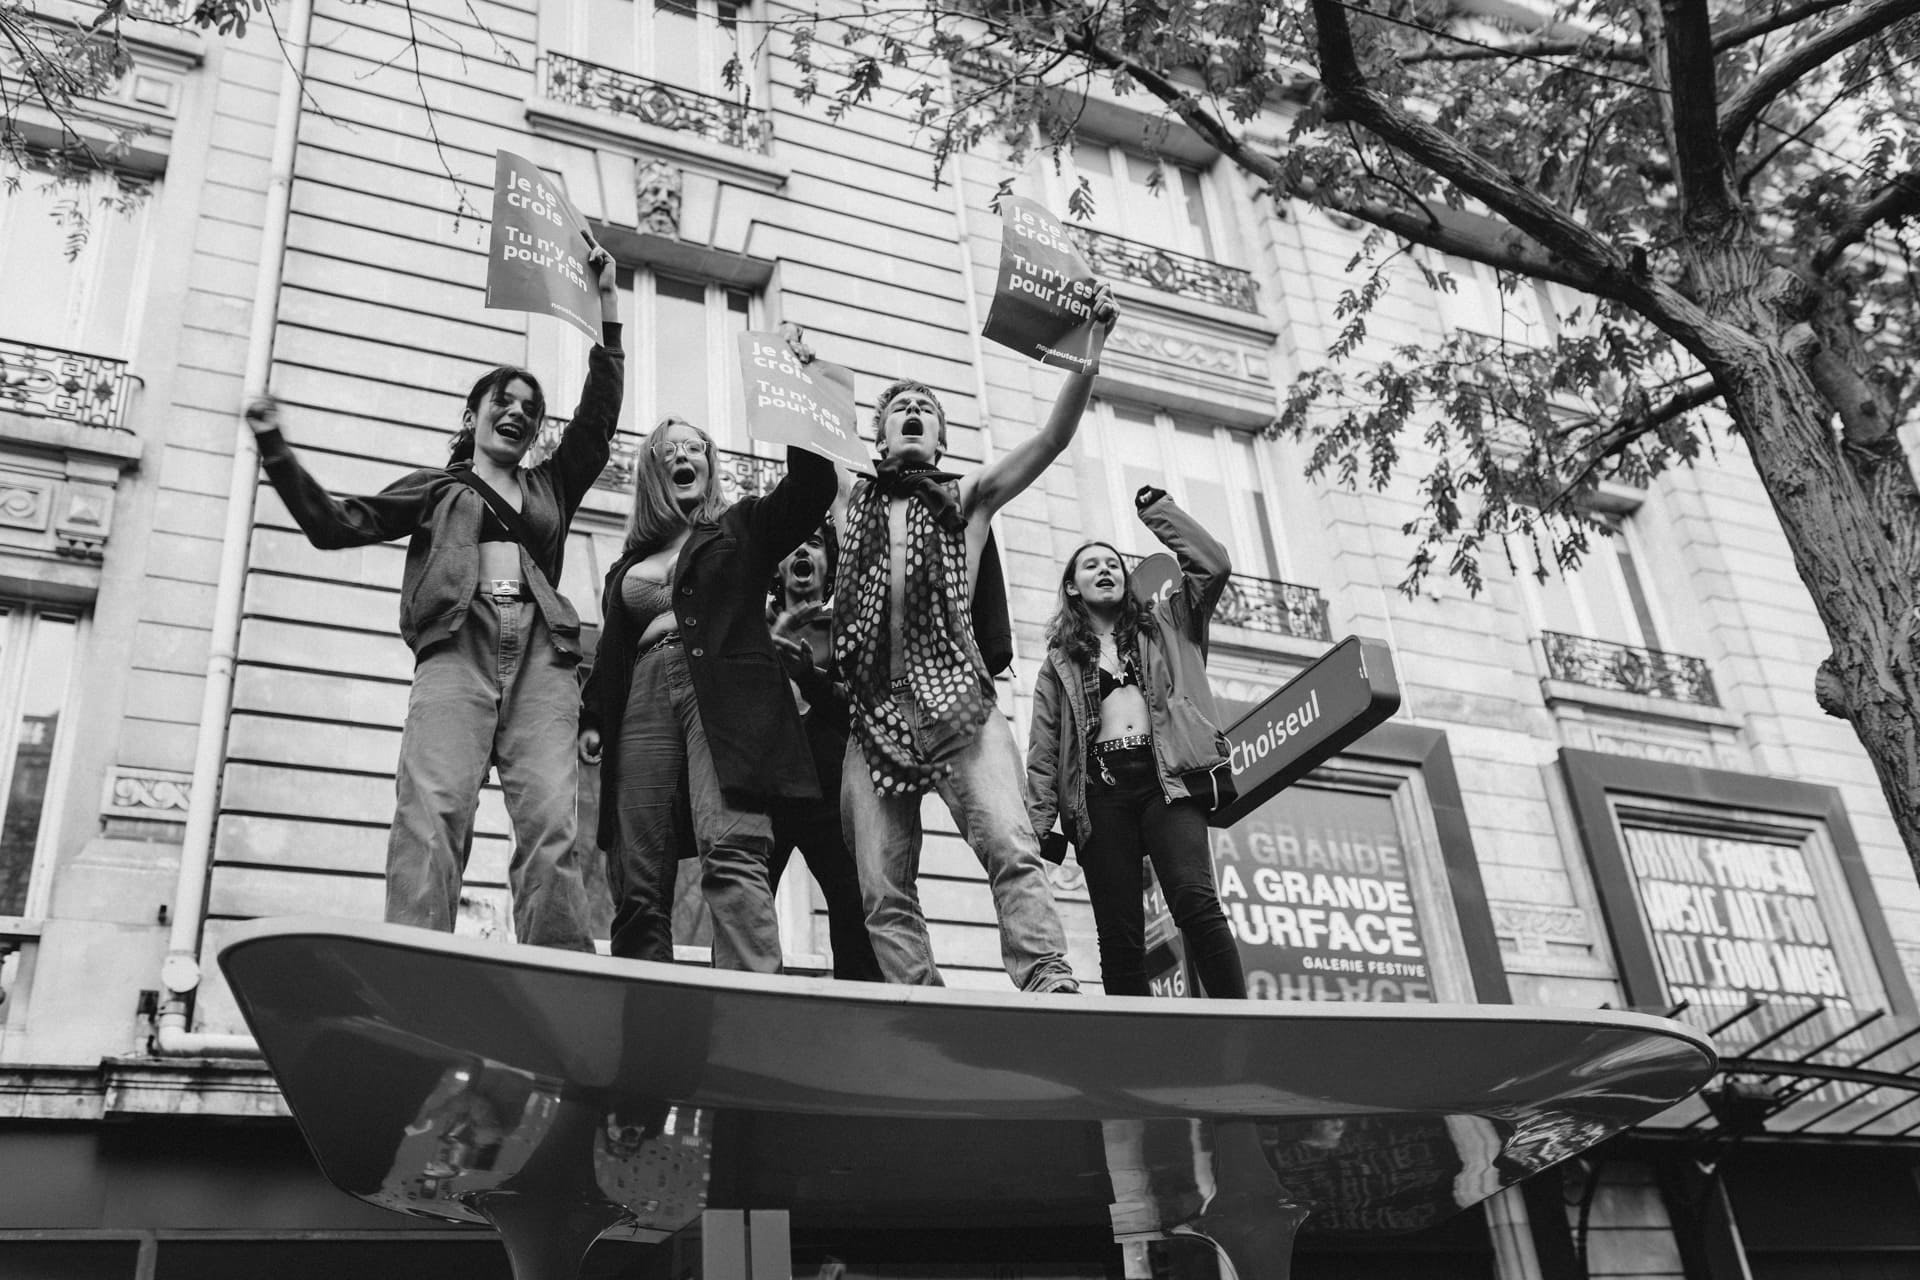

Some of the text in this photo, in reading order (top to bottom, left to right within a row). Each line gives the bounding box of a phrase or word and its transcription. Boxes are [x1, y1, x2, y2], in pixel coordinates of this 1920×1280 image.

[507, 170, 556, 207] Je te
[507, 192, 562, 227] crois
[1013, 206, 1061, 238] Je te
[505, 226, 532, 245] Tu
[568, 256, 584, 275] es
[1014, 223, 1070, 254] crois
[504, 244, 587, 292] pour rien
[1013, 254, 1037, 276] Tu
[1073, 281, 1093, 299] es
[1008, 274, 1091, 320] pour rien
[752, 342, 776, 357] Je
[757, 380, 784, 396] Tu
[758, 395, 847, 440] pour rien
[1231, 689, 1321, 776] Choiseul
[1248, 832, 1405, 878] GRANDE
[1252, 867, 1414, 914] GRANDE
[1152, 970, 1185, 999] N16
[1302, 956, 1426, 978] GALERIE FESTIVE
